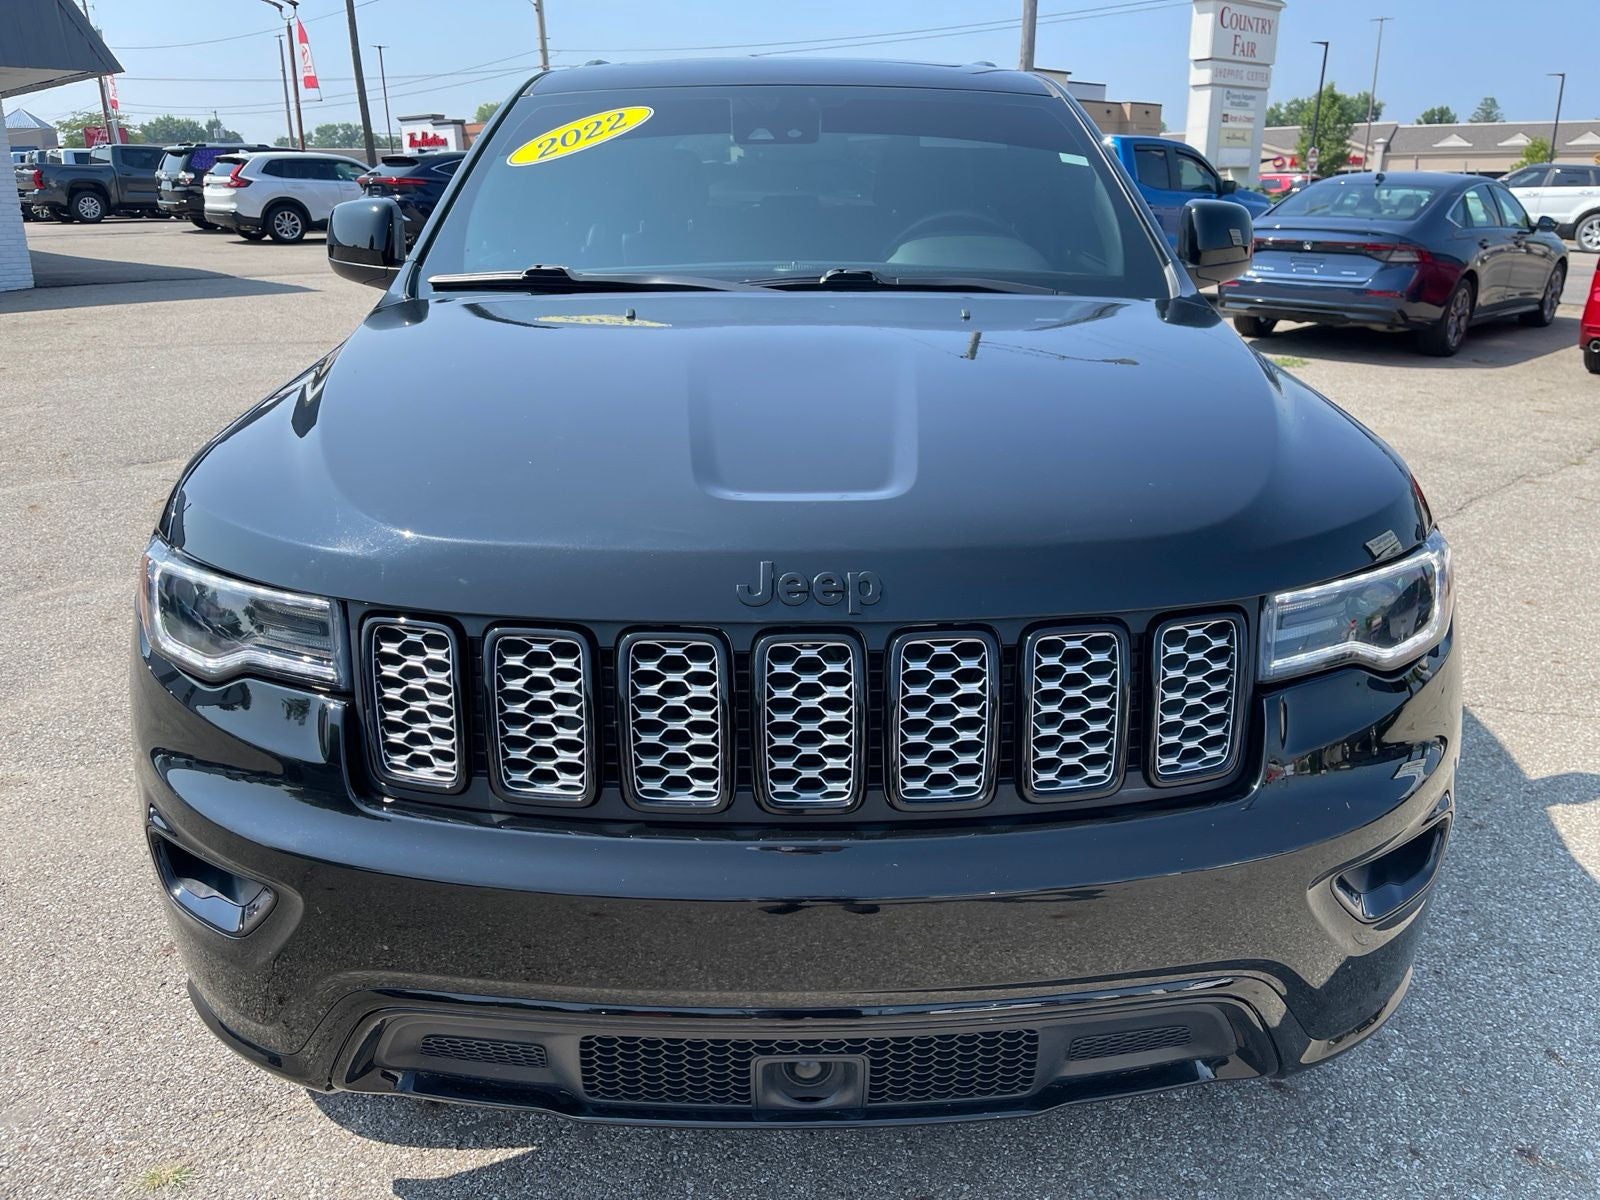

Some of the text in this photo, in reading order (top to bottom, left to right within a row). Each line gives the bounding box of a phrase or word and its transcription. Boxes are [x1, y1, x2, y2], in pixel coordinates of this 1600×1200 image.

[1220, 6, 1273, 35] COUNTRY
[1232, 34, 1256, 58] FAIR
[537, 112, 627, 159] 2022
[736, 560, 882, 615] Jeep
